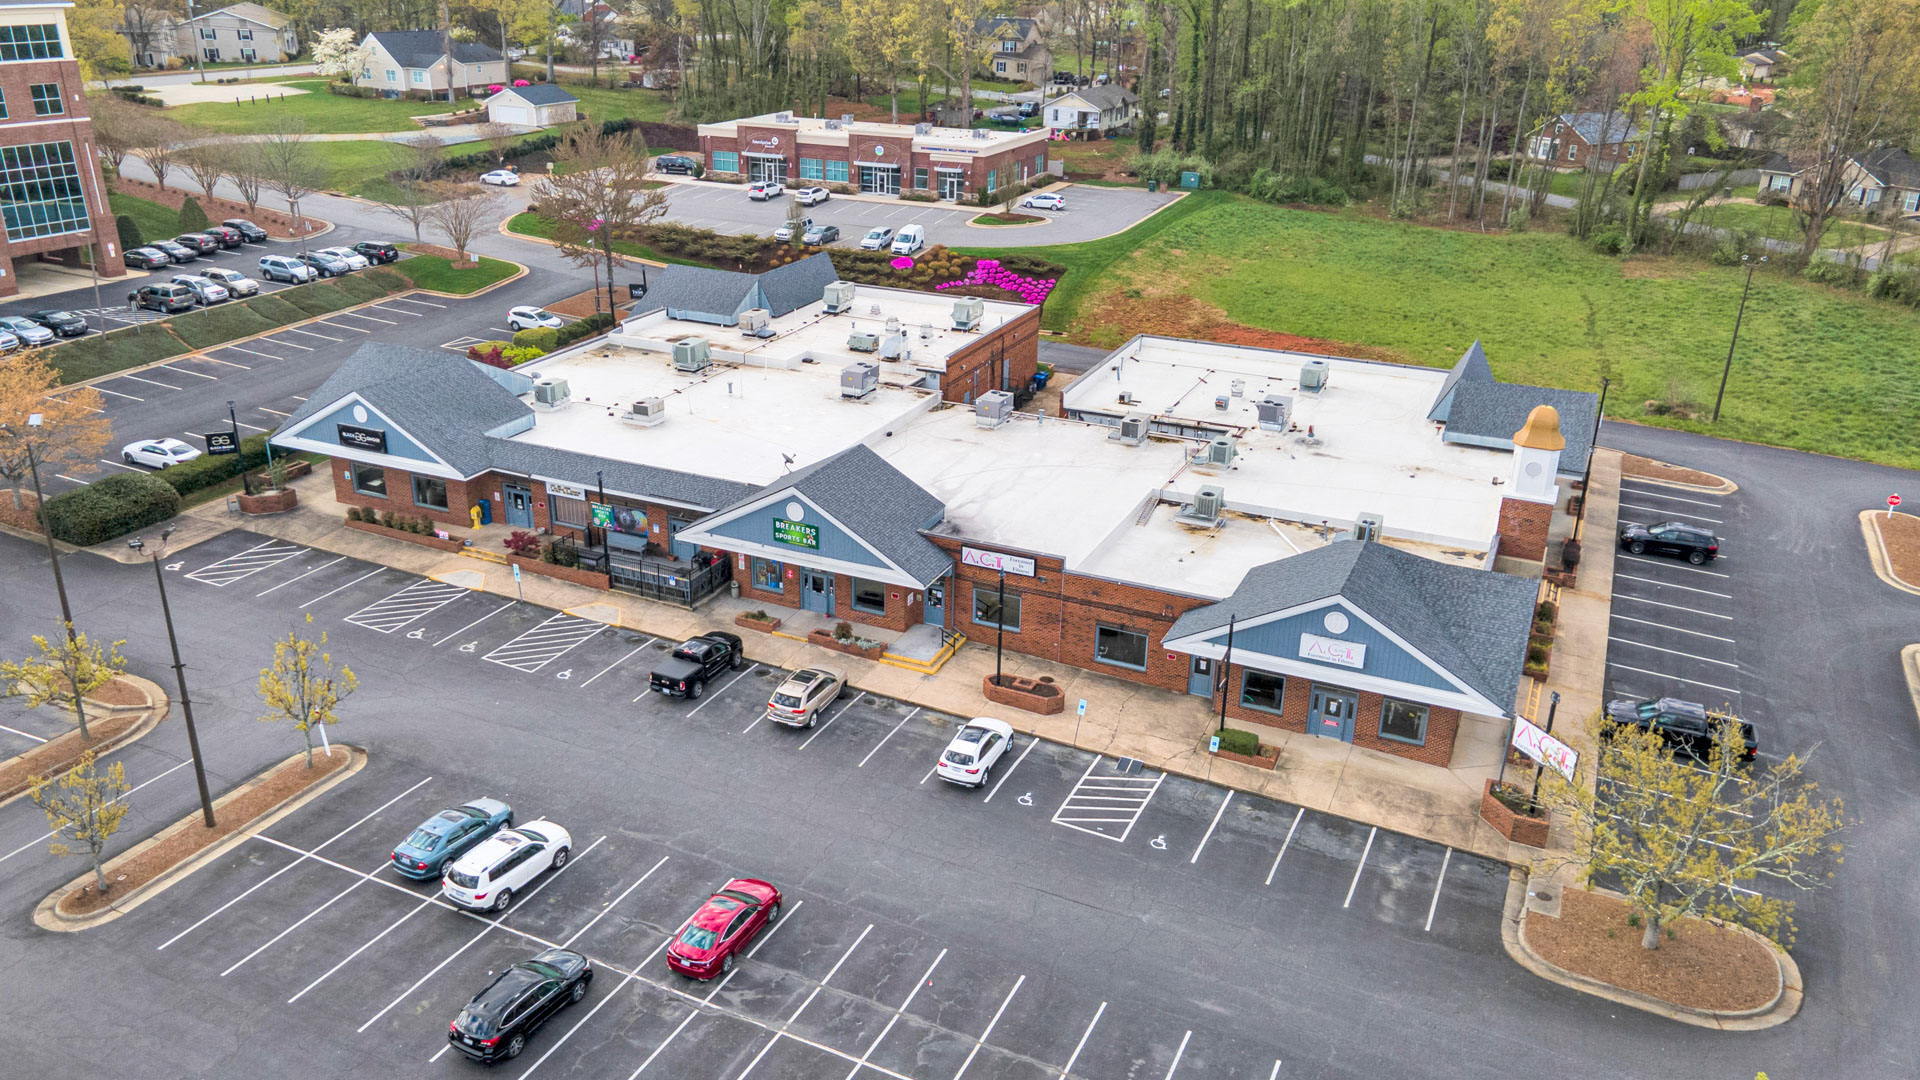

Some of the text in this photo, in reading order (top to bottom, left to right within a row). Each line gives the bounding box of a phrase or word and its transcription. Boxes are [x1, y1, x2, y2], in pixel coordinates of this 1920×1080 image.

[775, 521, 817, 536] BREAKERS
[775, 532, 817, 547] SPORTS BAR
